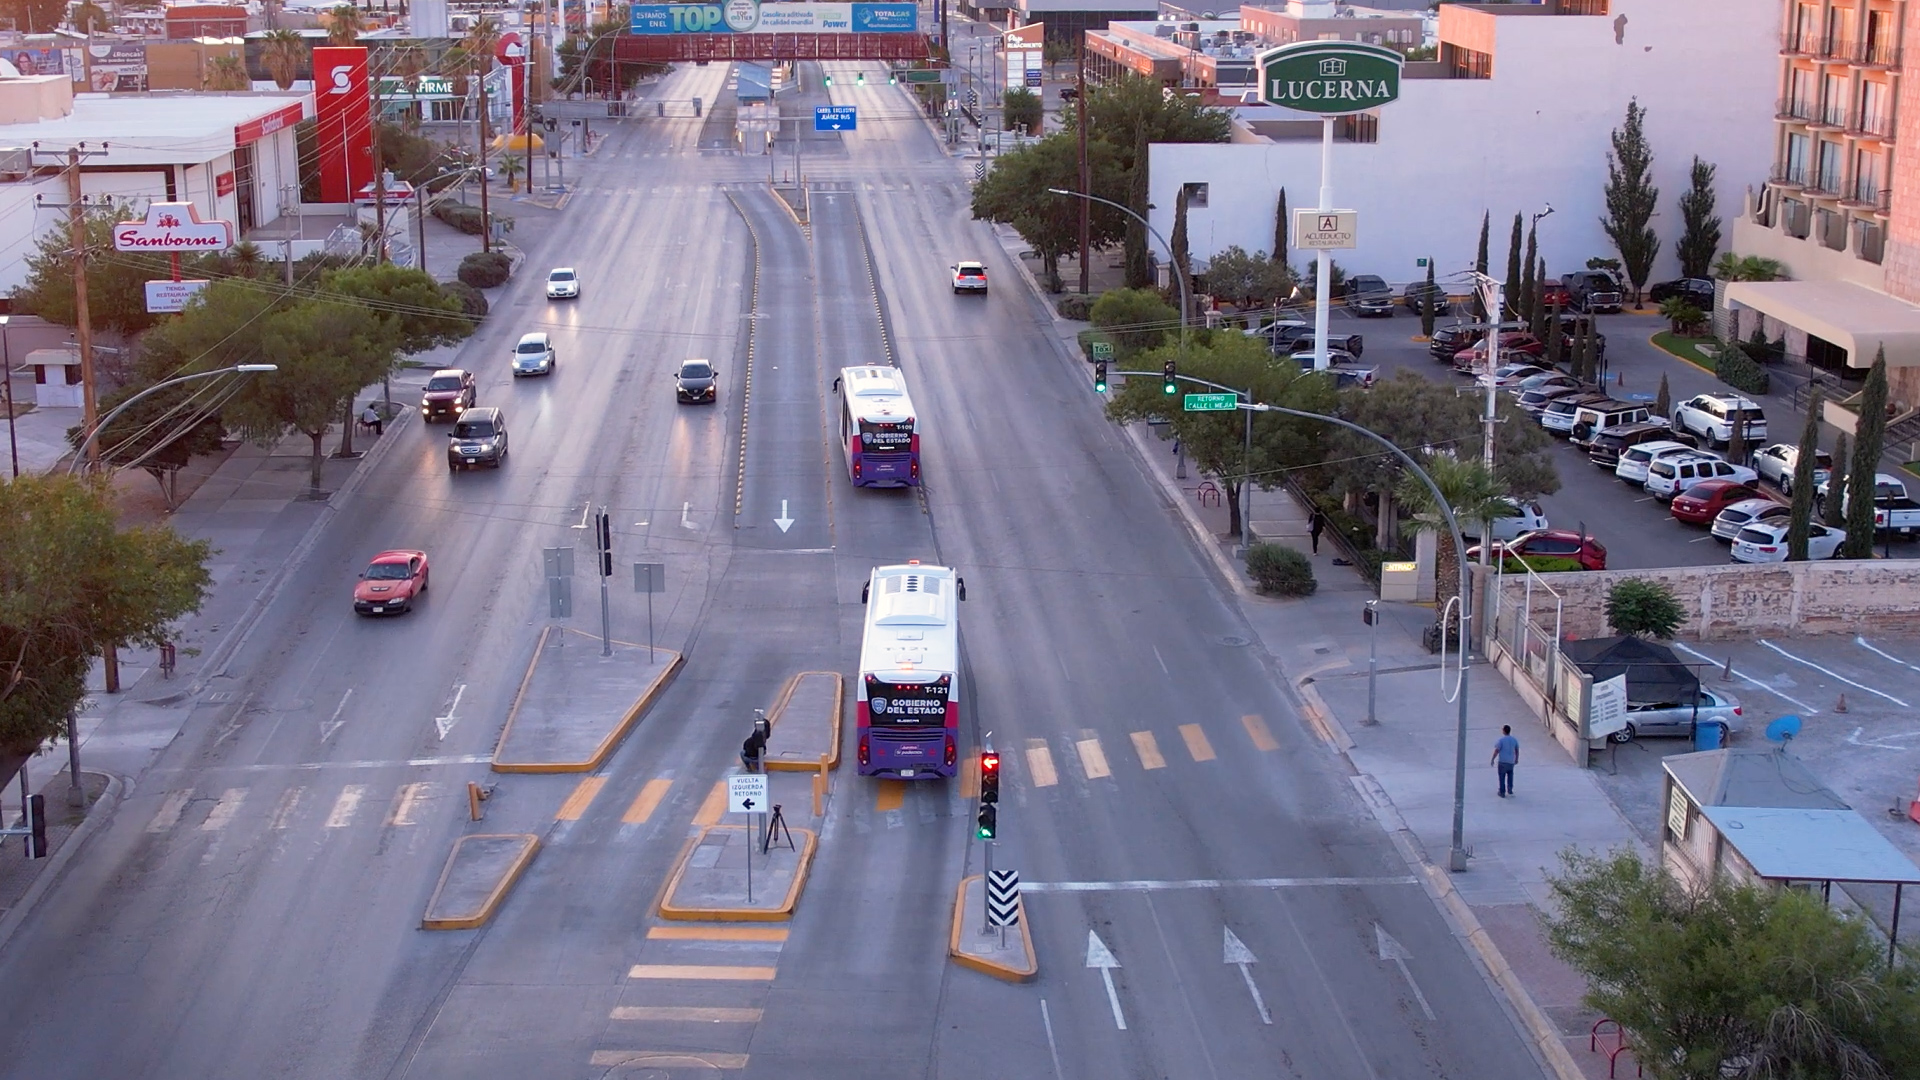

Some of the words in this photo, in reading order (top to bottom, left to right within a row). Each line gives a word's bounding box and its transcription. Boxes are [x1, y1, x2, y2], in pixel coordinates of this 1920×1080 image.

[669, 6, 722, 32] TOP
[822, 20, 848, 28] Power
[1271, 79, 1391, 101] LUCERNA
[119, 230, 222, 247] Sanborns
[1304, 232, 1352, 241] ACUEDUCTO
[924, 686, 948, 694] T-121
[891, 699, 941, 707] GOBIERNO
[887, 706, 905, 714] DEL
[907, 707, 945, 715] ESTADO
